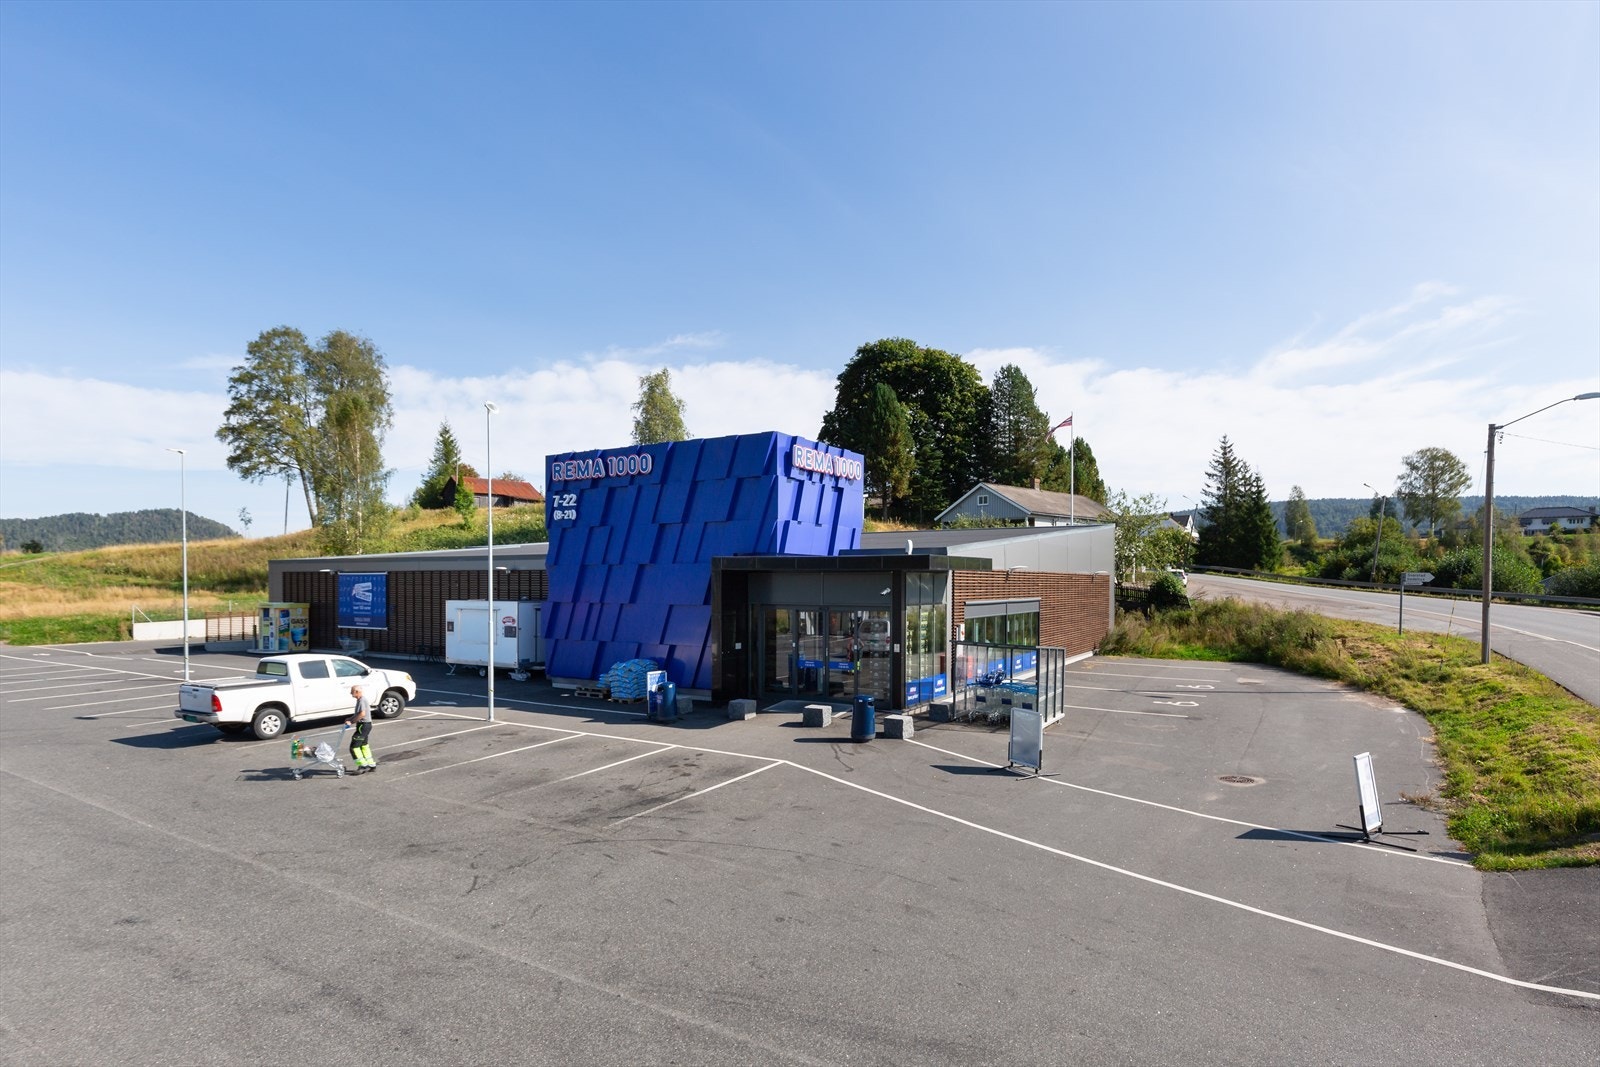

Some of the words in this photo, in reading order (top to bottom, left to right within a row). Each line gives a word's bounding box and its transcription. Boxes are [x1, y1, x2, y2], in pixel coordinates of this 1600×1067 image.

[552, 458, 605, 480] REMA
[608, 453, 652, 476] 1000
[793, 445, 833, 475] REMA
[834, 456, 861, 480] 1000
[553, 493, 577, 507] 7-22
[553, 509, 577, 520] (8-21)
